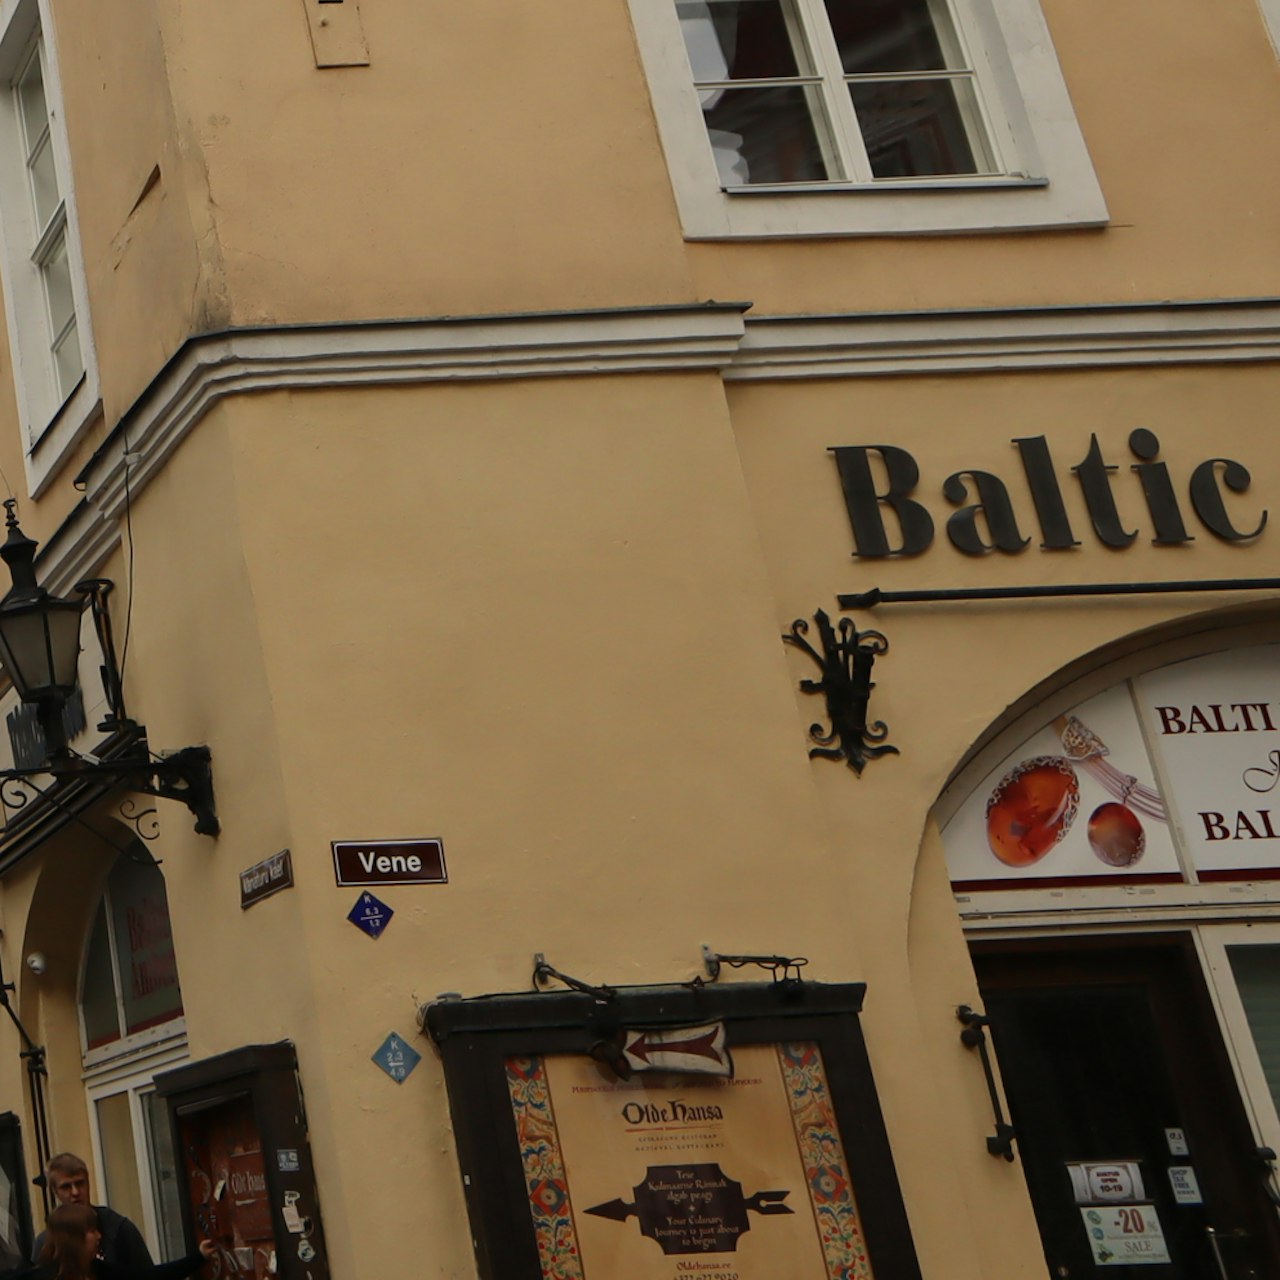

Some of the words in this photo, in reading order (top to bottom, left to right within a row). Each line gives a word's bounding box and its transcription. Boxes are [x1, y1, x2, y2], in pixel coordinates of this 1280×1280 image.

[826, 427, 1268, 559] Baltic
[1154, 703, 1278, 735] BALTI
[357, 851, 422, 873] Vene
[363, 894, 371, 903] K
[390, 1040, 399, 1050] K
[622, 1102, 668, 1124] Olde
[1099, 1185, 1123, 1193] 10-19
[1114, 1208, 1145, 1234] -20
[1125, 1241, 1153, 1253] SALE
